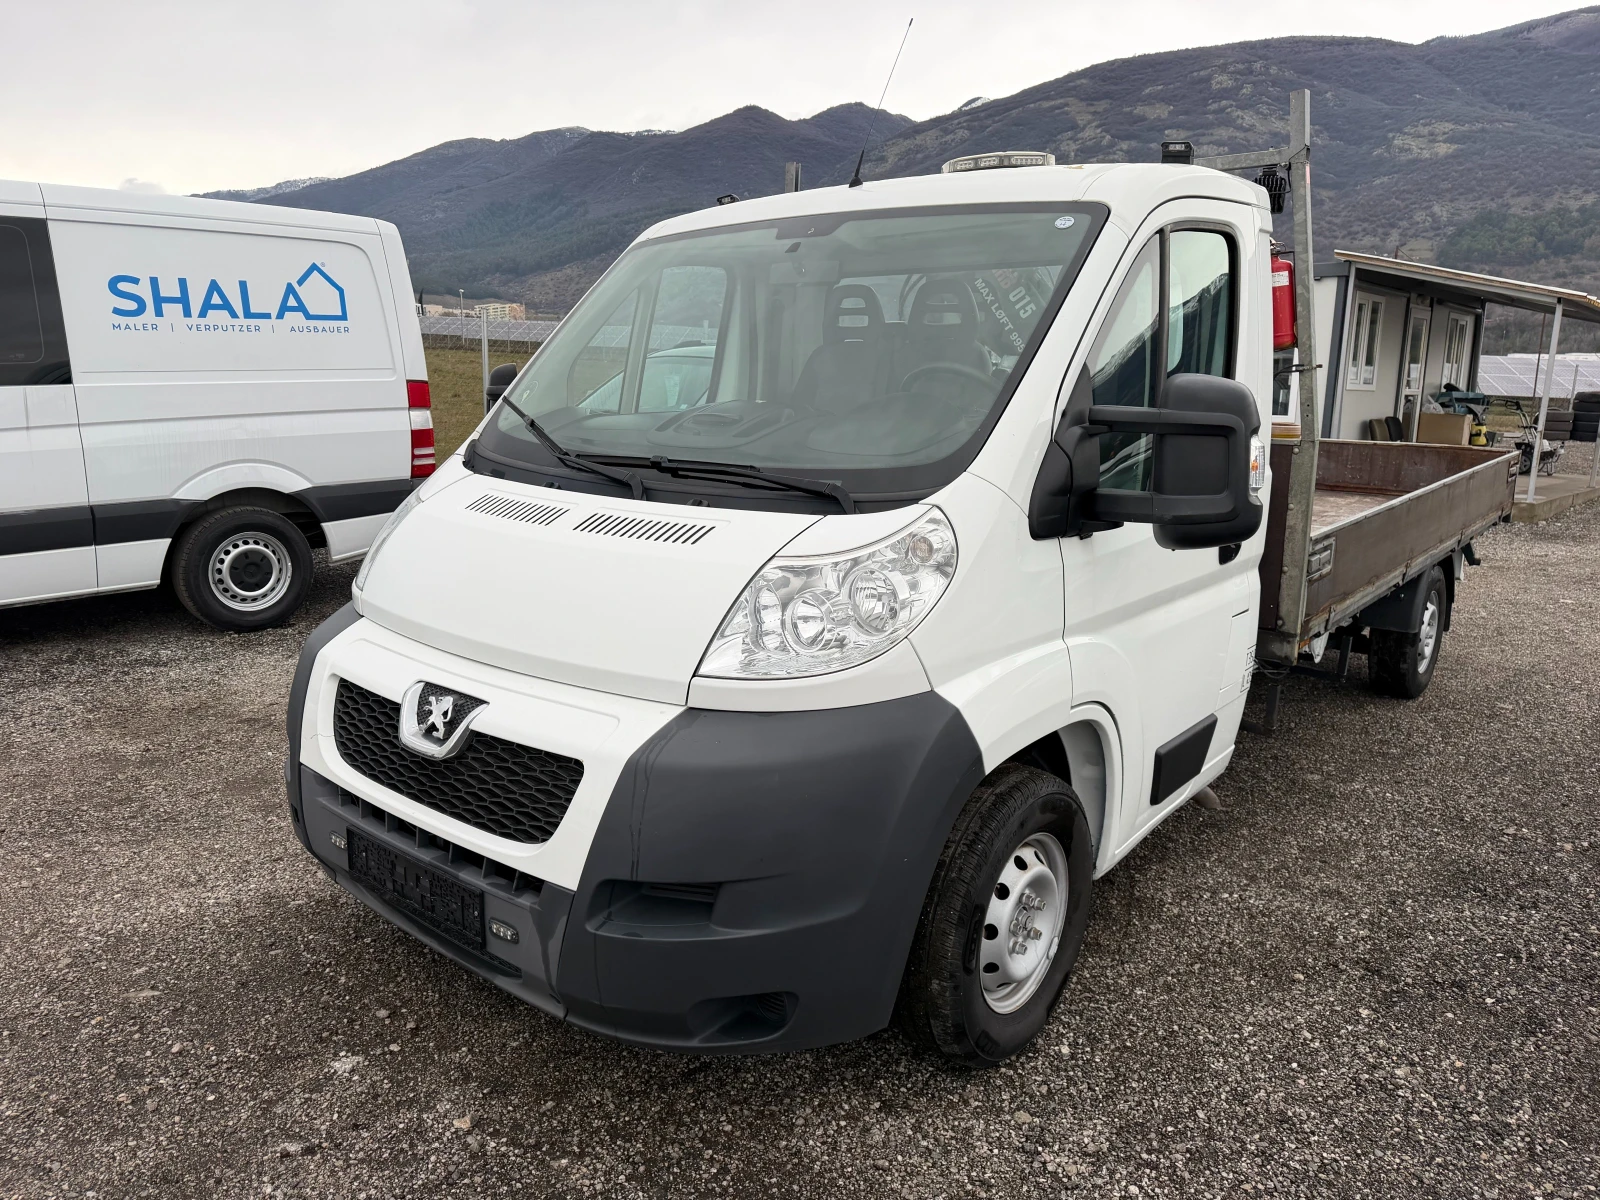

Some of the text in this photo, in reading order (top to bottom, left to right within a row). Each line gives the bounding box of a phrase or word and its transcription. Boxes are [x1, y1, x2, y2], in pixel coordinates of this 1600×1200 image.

[108, 274, 310, 321] SHALA
[974, 278, 995, 304] MAX
[1009, 332, 1026, 352] 995
[1008, 286, 1037, 319] 015
[112, 322, 159, 332] MALER
[186, 324, 261, 333] VERPUTZER
[290, 325, 350, 334] AUSBAUER
